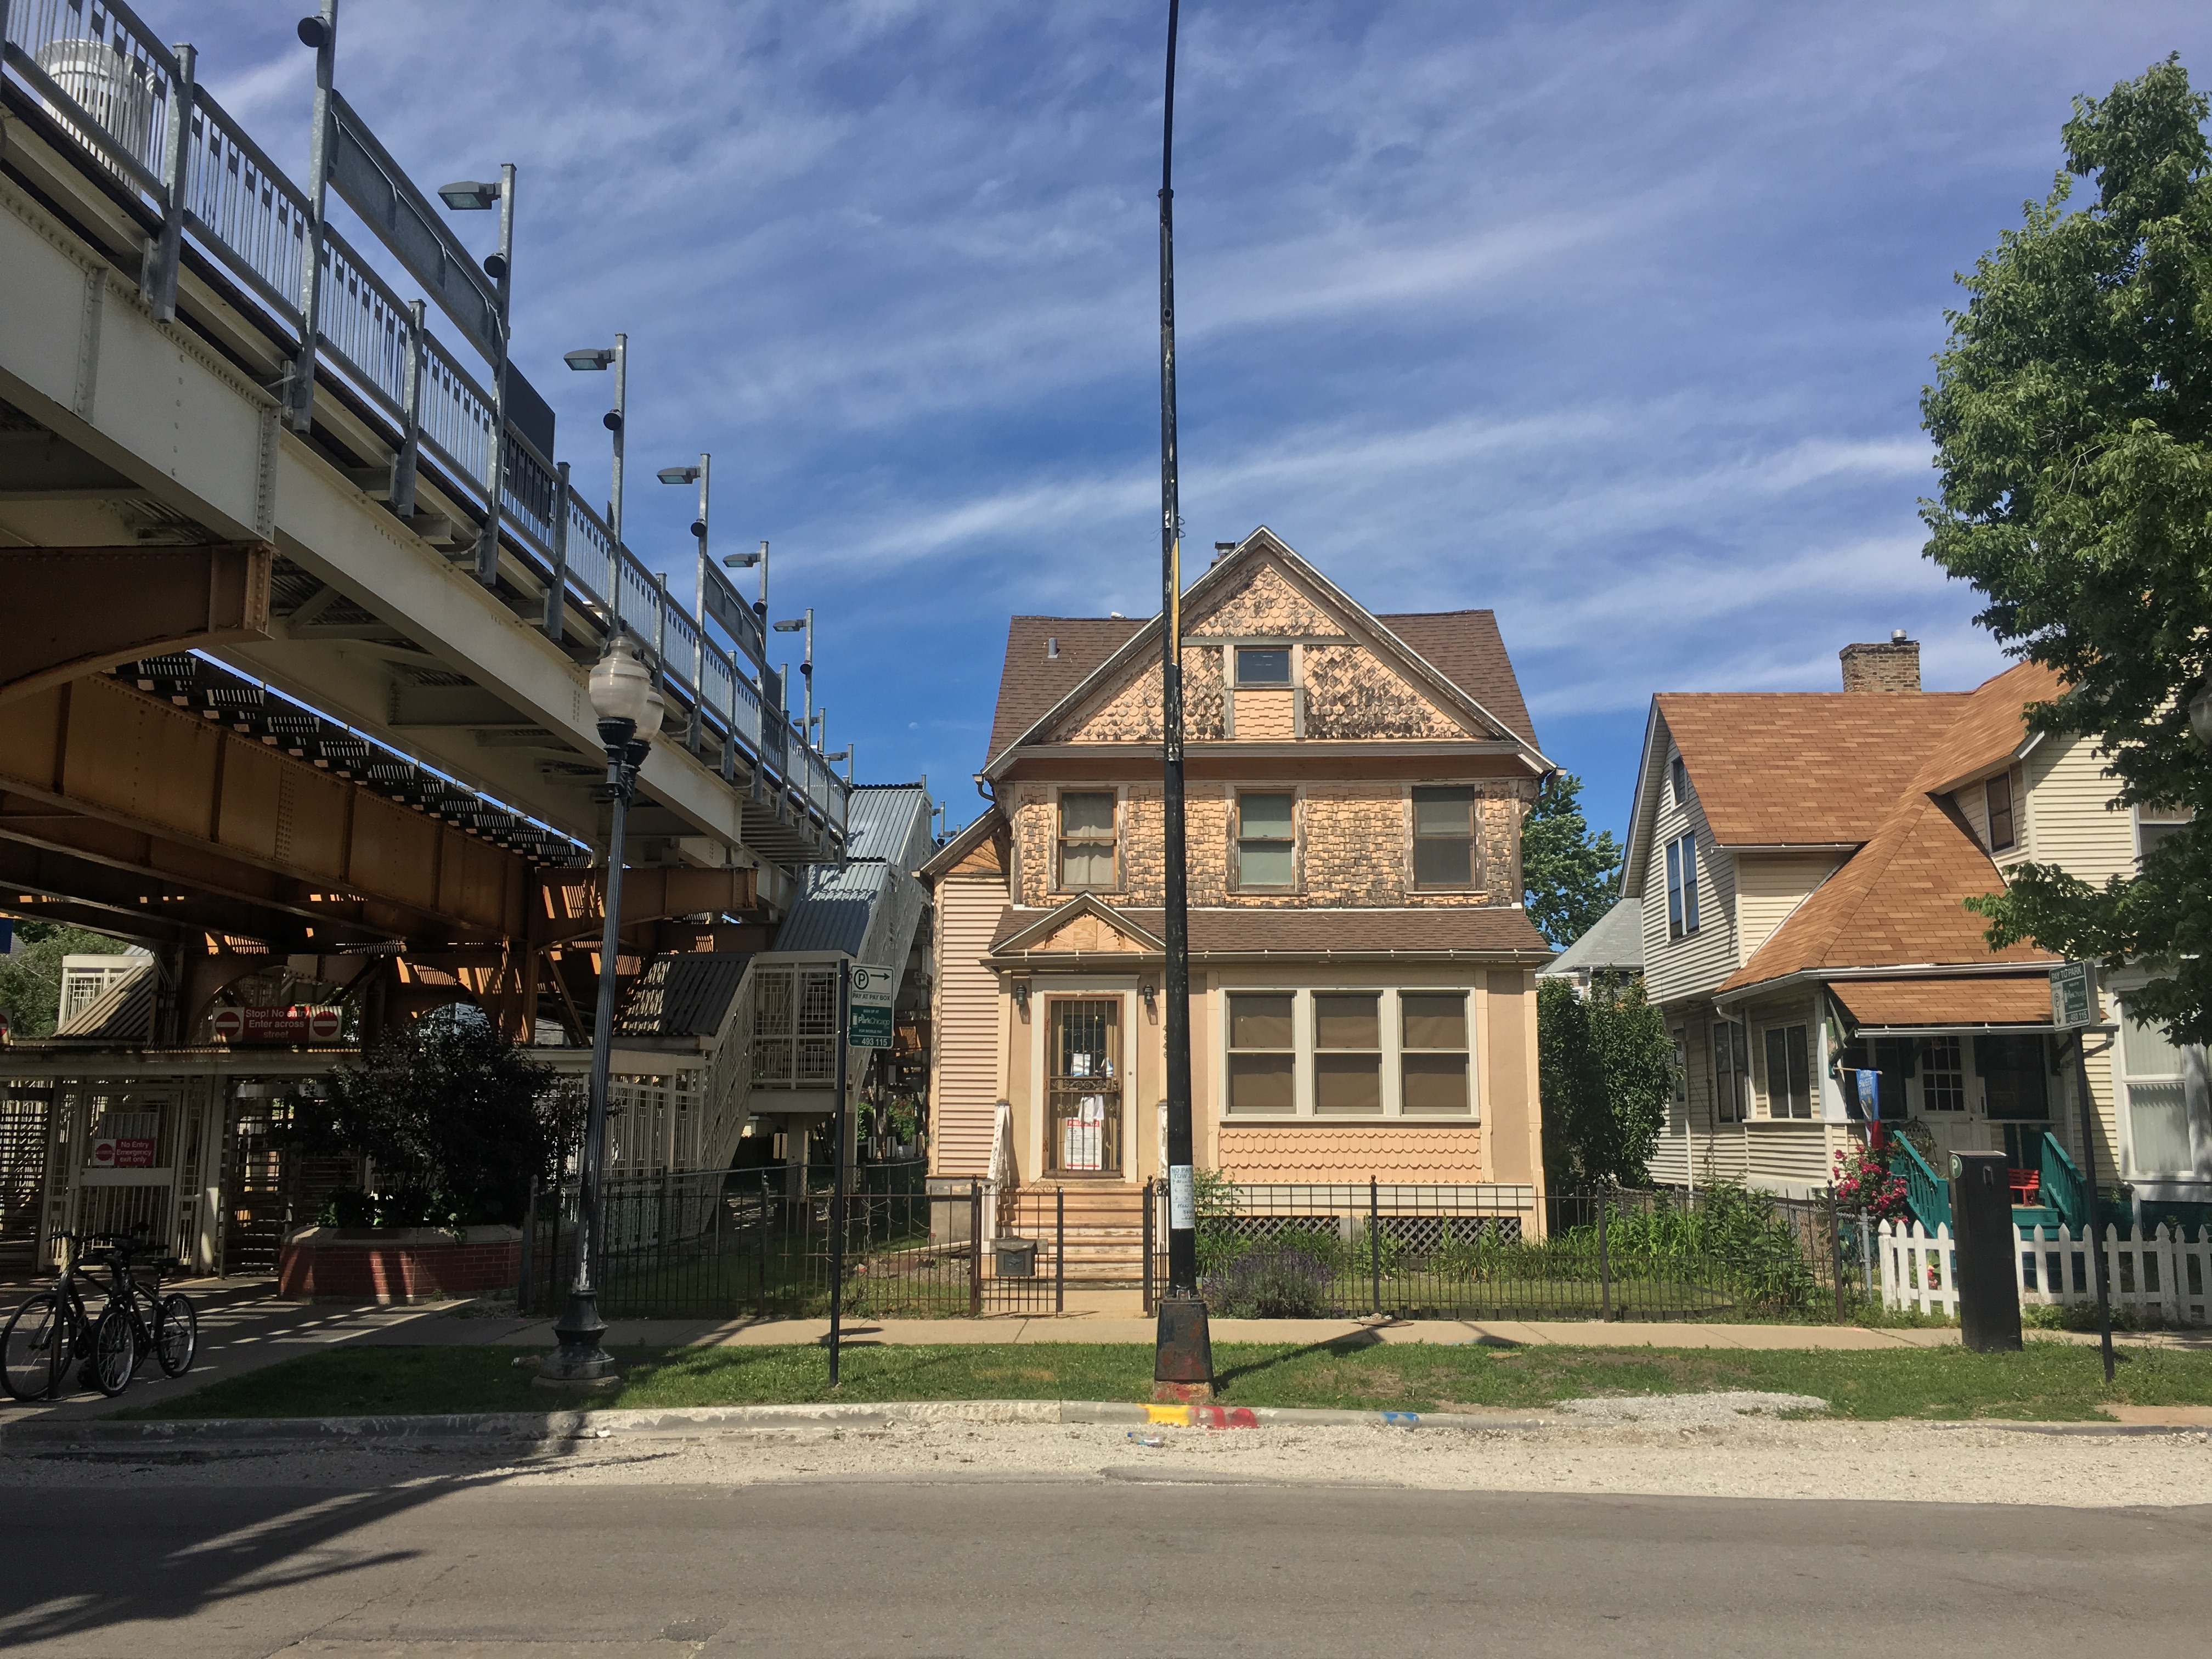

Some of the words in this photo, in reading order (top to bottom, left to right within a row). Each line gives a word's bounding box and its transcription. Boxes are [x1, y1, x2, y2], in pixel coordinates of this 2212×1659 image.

[2051, 971, 2060, 981] PAY
[2060, 969, 2068, 979] TO
[2068, 966, 2082, 977] PARK
[245, 1009, 269, 1019] Stop!
[286, 1009, 309, 1019] entry
[2079, 1011, 2087, 1020] 115
[249, 1020, 272, 1028] Enter
[858, 1016, 890, 1027] ParkChicago
[263, 1030, 289, 1039] street
[862, 1037, 874, 1046] 493
[876, 1038, 888, 1046] 115
[132, 1141, 149, 1149] Entry
